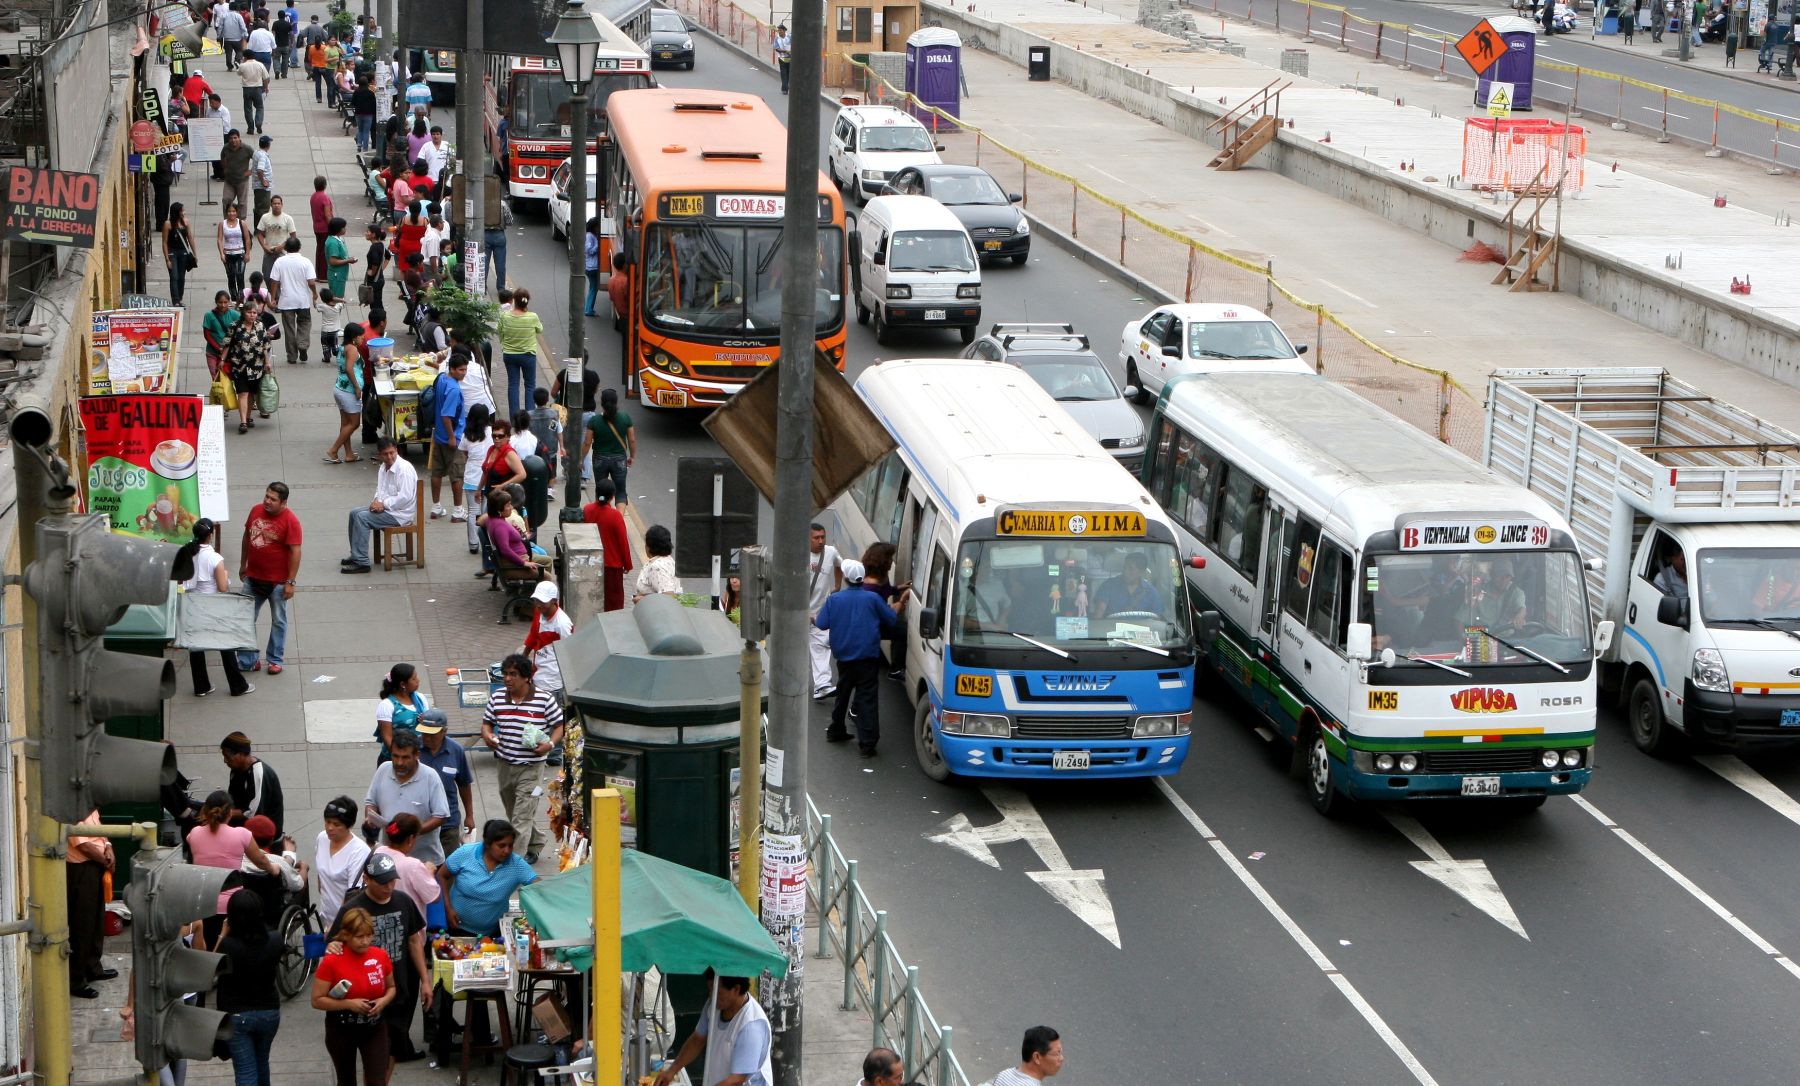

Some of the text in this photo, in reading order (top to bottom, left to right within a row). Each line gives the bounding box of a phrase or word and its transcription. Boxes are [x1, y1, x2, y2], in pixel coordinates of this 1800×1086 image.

[926, 54, 953, 63] DISAL
[143, 89, 162, 121] COP
[155, 145, 179, 155] FOTO
[517, 144, 546, 152] COVIDA
[14, 204, 77, 221] AL FONDO
[671, 199, 703, 213] NM-16
[7, 216, 94, 236] A LA DERECHA
[662, 393, 682, 405] NM-16
[81, 400, 200, 429] CALDO GALLINA
[95, 415, 110, 430] DE
[90, 464, 146, 492] Jugos
[1058, 515, 1067, 532] T.
[1091, 515, 1141, 531] LIMA
[1403, 528, 1419, 548] B
[1424, 526, 1470, 544] VENTANILLA
[1501, 525, 1528, 543] LINCE
[1531, 526, 1548, 545] 39
[960, 677, 990, 693] SM-25
[1450, 687, 1518, 713] VIPUSA
[1540, 696, 1583, 706] ROSA
[1055, 757, 1088, 768] VI-2494
